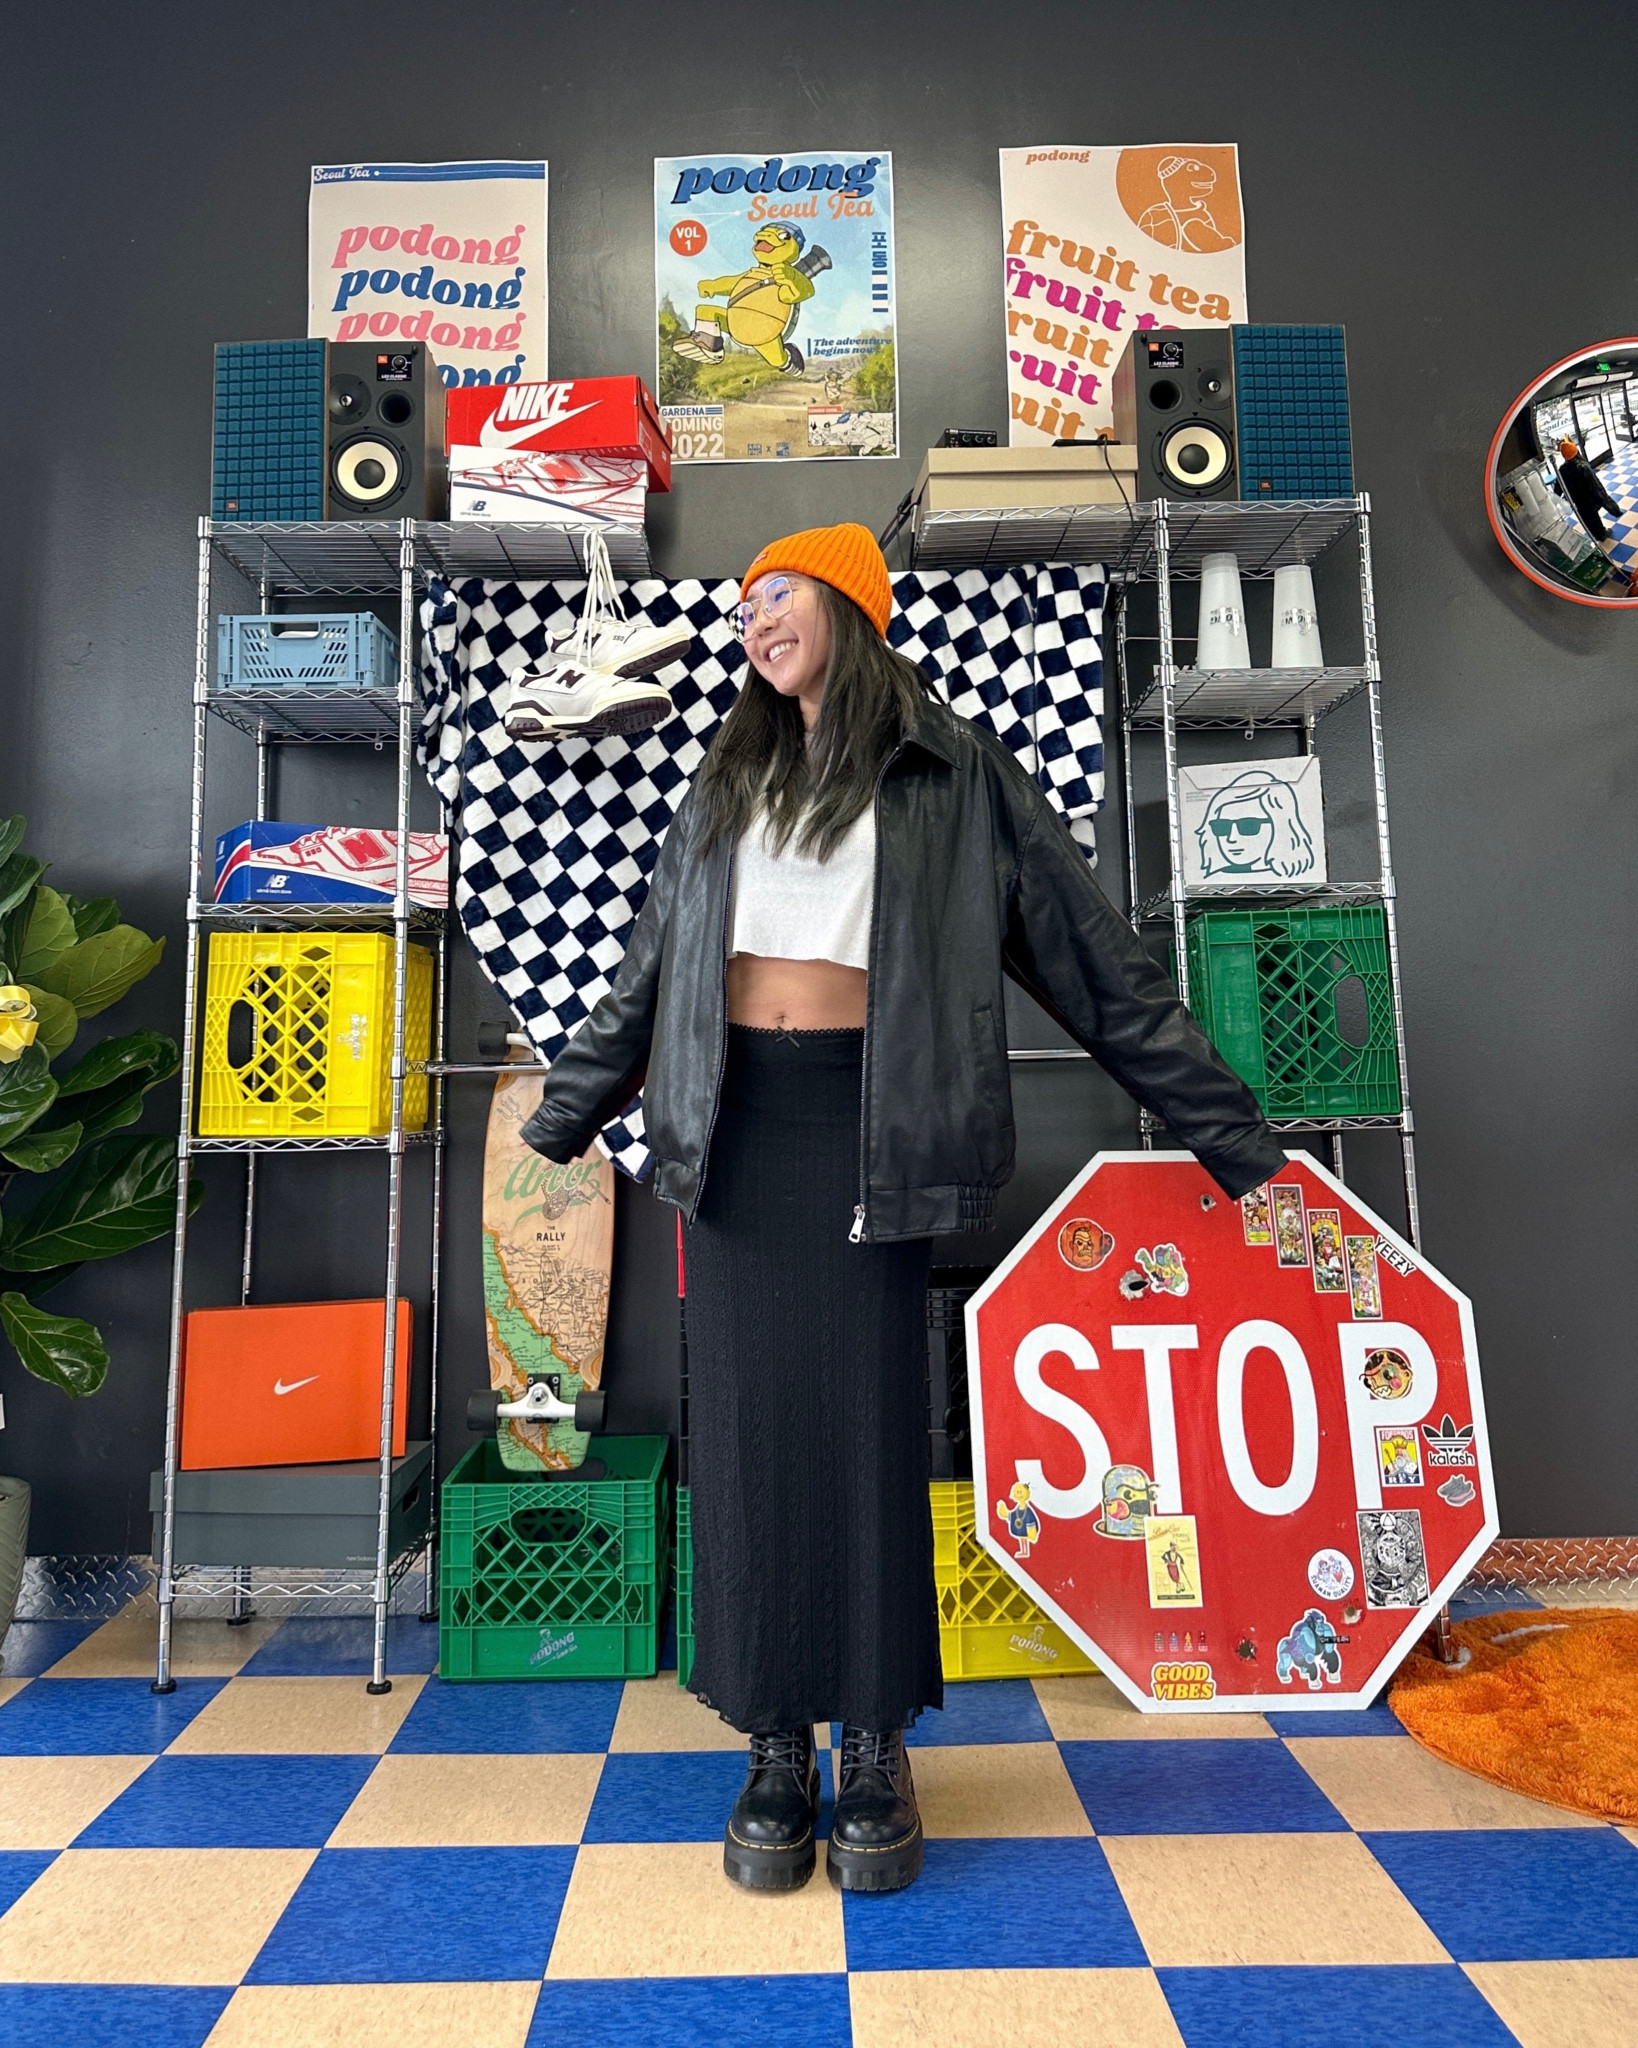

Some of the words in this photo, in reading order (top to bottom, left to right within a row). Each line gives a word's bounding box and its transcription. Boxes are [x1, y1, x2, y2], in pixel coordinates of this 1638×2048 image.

[1026, 150, 1091, 165] podong
[314, 168, 346, 182] Seoul
[349, 166, 370, 179] Tea
[671, 157, 881, 204] podong
[747, 194, 819, 222] Seoul
[827, 190, 875, 220] Tea
[676, 227, 700, 239] VOL
[684, 239, 692, 251] 1
[331, 224, 526, 268] podong
[1006, 219, 1140, 292] fruit
[1148, 273, 1231, 321] tea
[331, 266, 526, 312] podong
[1006, 257, 1126, 331] fruit
[336, 310, 526, 352] podong
[813, 338, 834, 347] The
[836, 337, 892, 346] adventure
[1006, 307, 1114, 368] ruit
[813, 346, 850, 357] begins
[496, 383, 574, 422] NIKE
[661, 407, 705, 416] GARDENA
[536, 1232, 566, 1241] RALLY
[1375, 1236, 1415, 1276] YEEZY
[1013, 1319, 1438, 1519] STOP
[1429, 1451, 1473, 1465] kalash
[1388, 1475, 1417, 1484] REY
[529, 1631, 575, 1665] PODONG
[1010, 1634, 1058, 1659] PODONG
[1154, 1664, 1210, 1682] GOOD
[1153, 1682, 1214, 1700] VIBES
